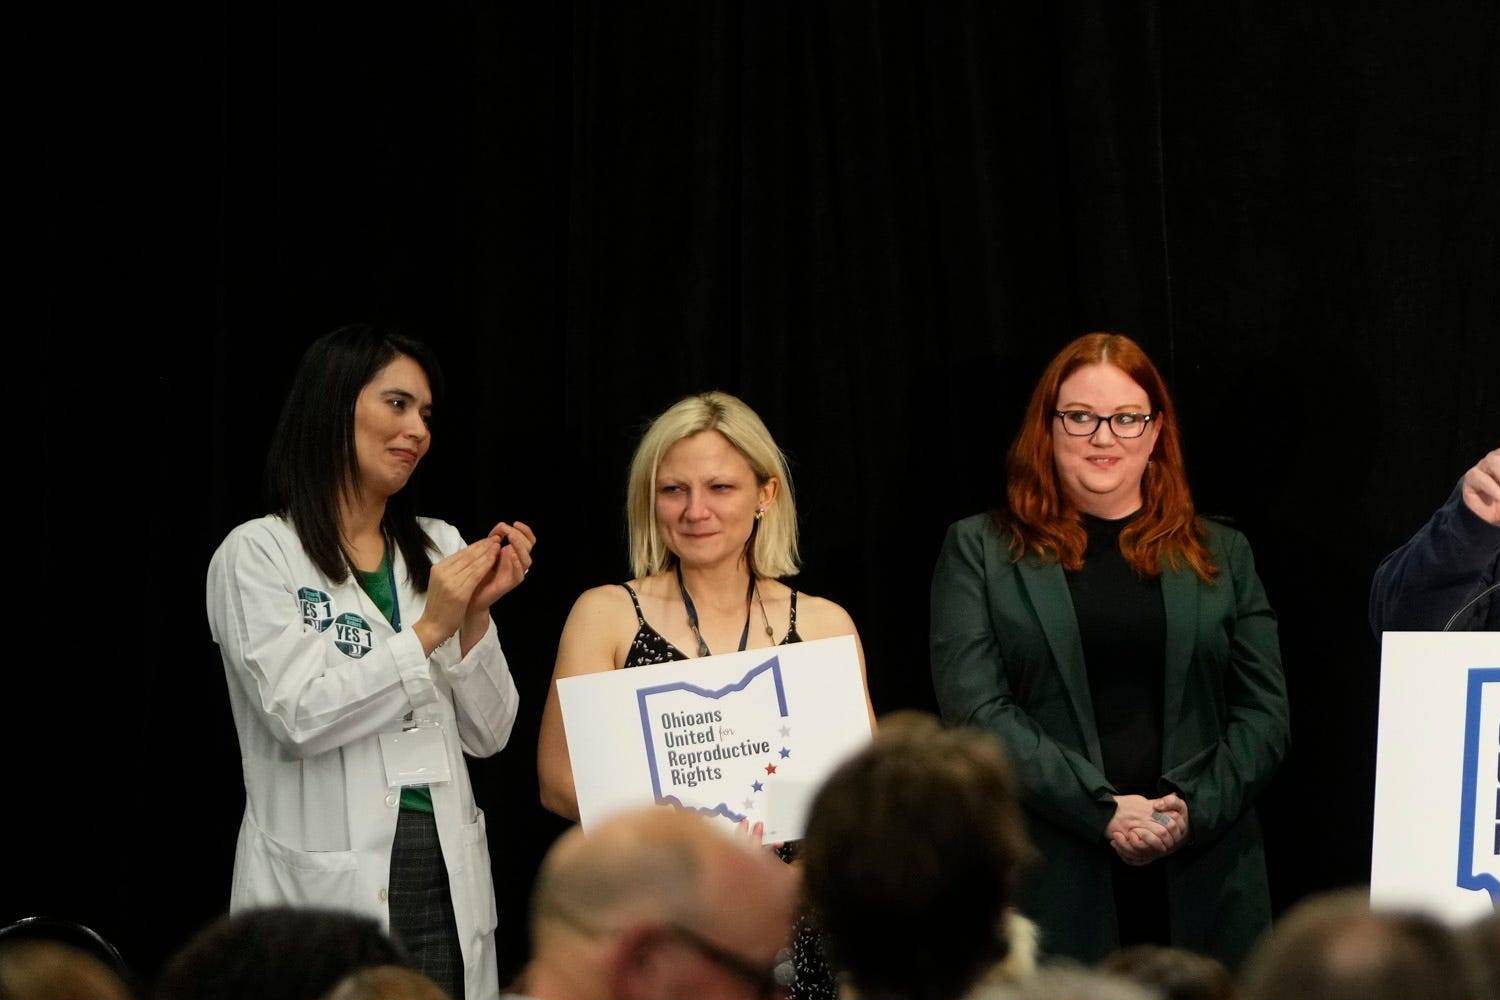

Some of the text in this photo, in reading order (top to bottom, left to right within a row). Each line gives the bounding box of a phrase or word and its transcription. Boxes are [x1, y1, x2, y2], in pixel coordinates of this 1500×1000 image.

[301, 601, 331, 619] ES 1
[336, 624, 372, 647] YES 1
[661, 710, 722, 729] Ohioans
[664, 725, 735, 748] United for
[668, 739, 770, 768] Reproductive
[671, 766, 722, 787] Rights
